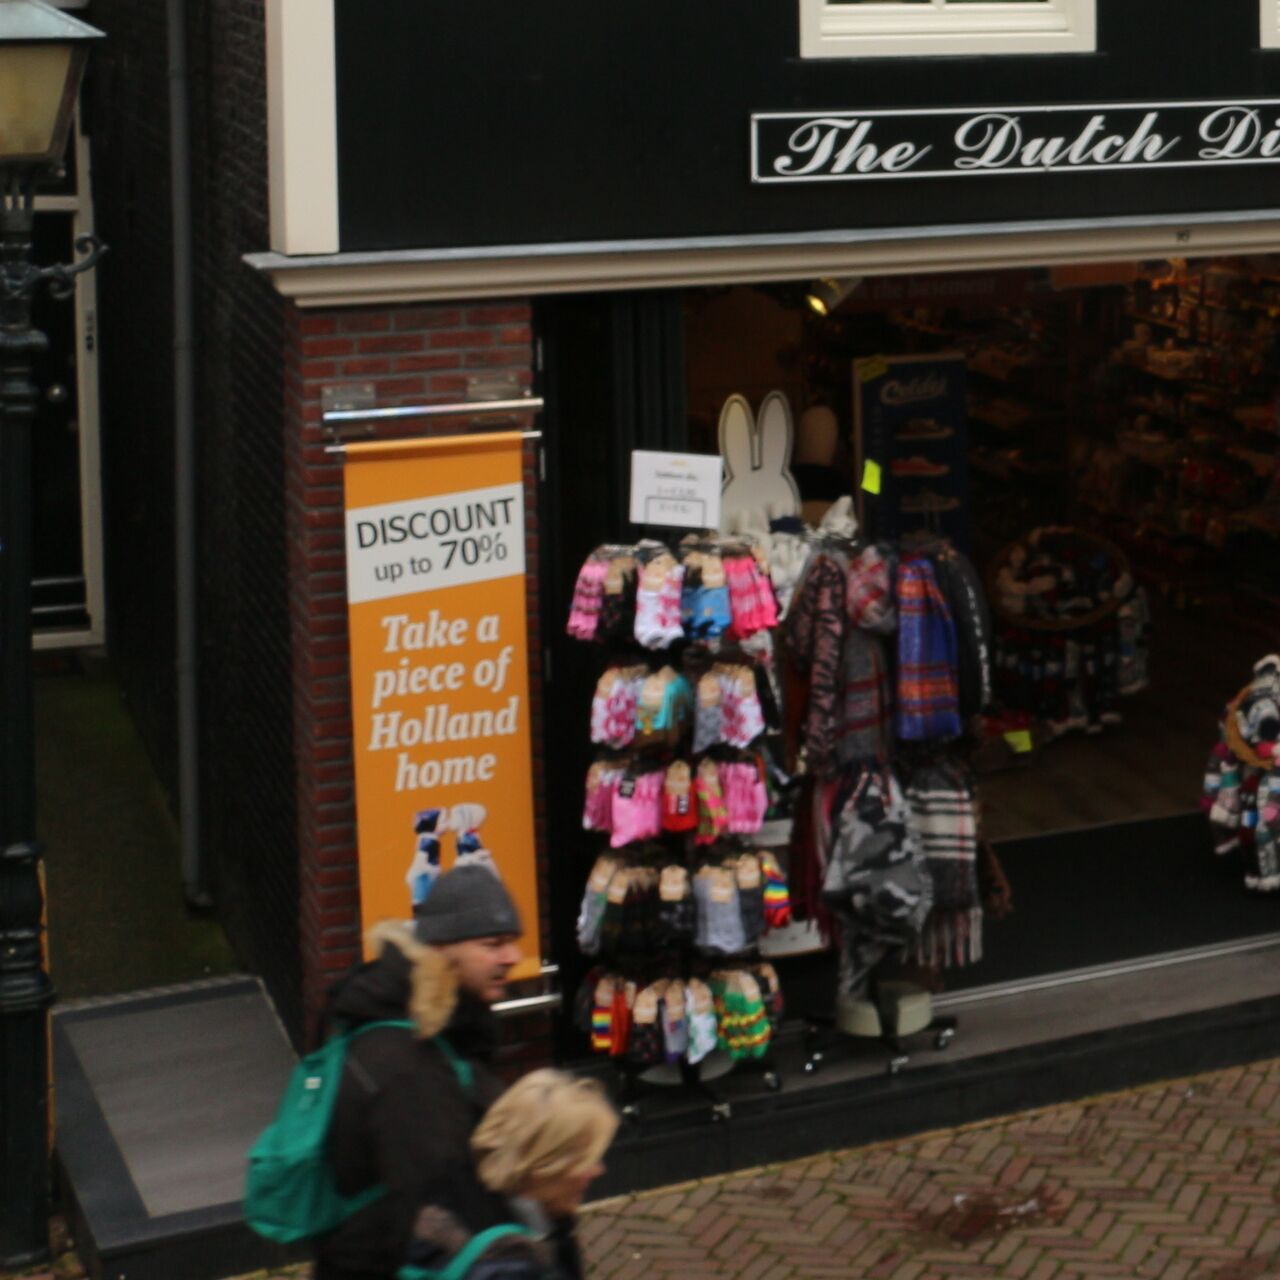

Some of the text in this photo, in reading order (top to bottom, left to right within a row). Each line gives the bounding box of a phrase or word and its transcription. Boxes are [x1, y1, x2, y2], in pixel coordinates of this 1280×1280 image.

[773, 117, 934, 176] The
[953, 111, 1182, 170] Dutch
[356, 497, 515, 549] DISCOUNT
[374, 531, 508, 584] up to 70%
[381, 609, 500, 653] Take a
[372, 645, 514, 709] piece of
[367, 695, 520, 751] Holland
[395, 751, 497, 792] home
